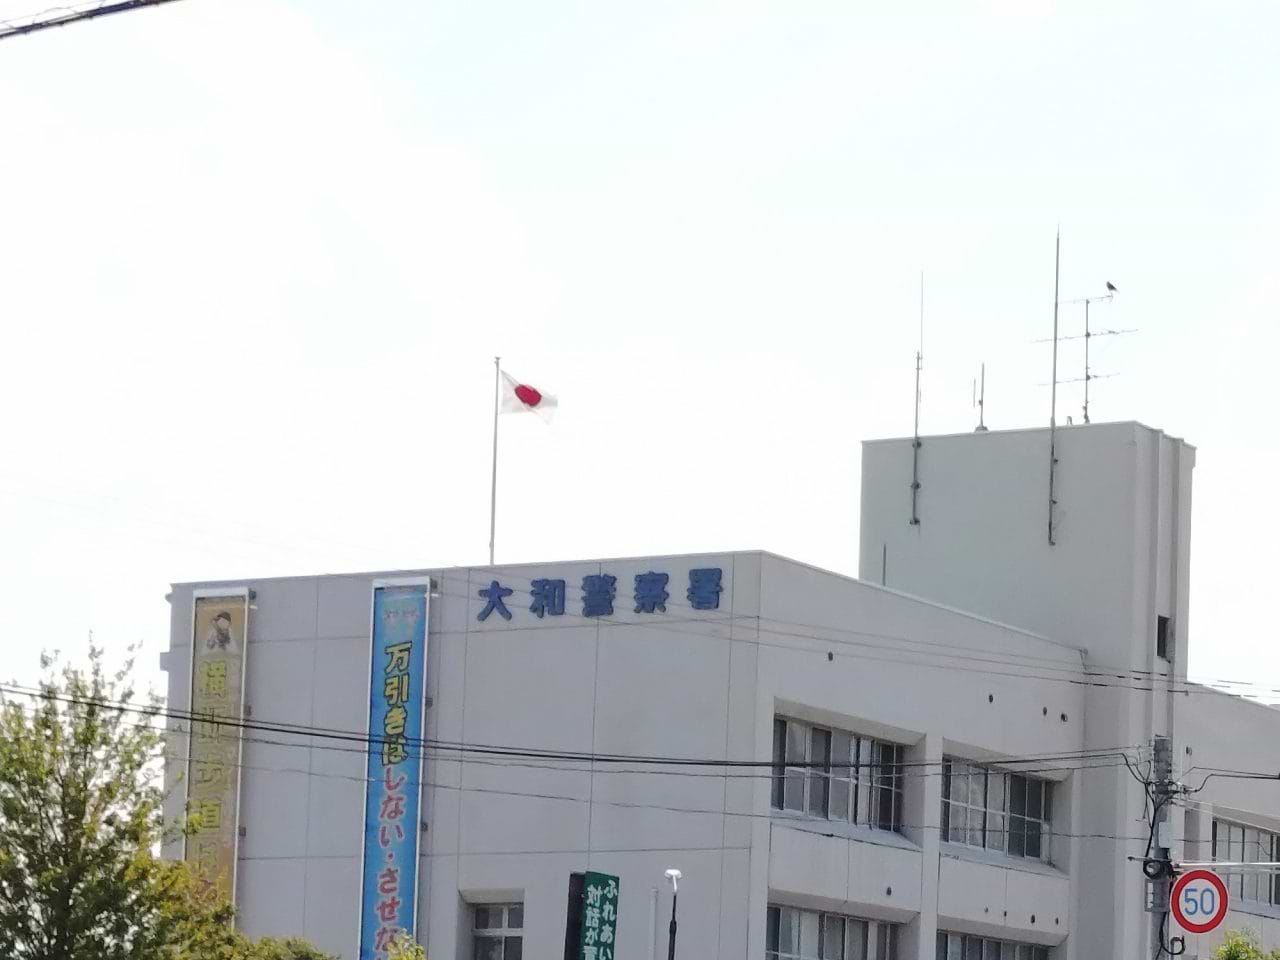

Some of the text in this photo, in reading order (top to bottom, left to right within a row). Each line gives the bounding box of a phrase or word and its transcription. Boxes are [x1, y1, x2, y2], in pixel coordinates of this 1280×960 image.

[477, 568, 723, 621] 大和警察署
[1184, 888, 1215, 916] 50
